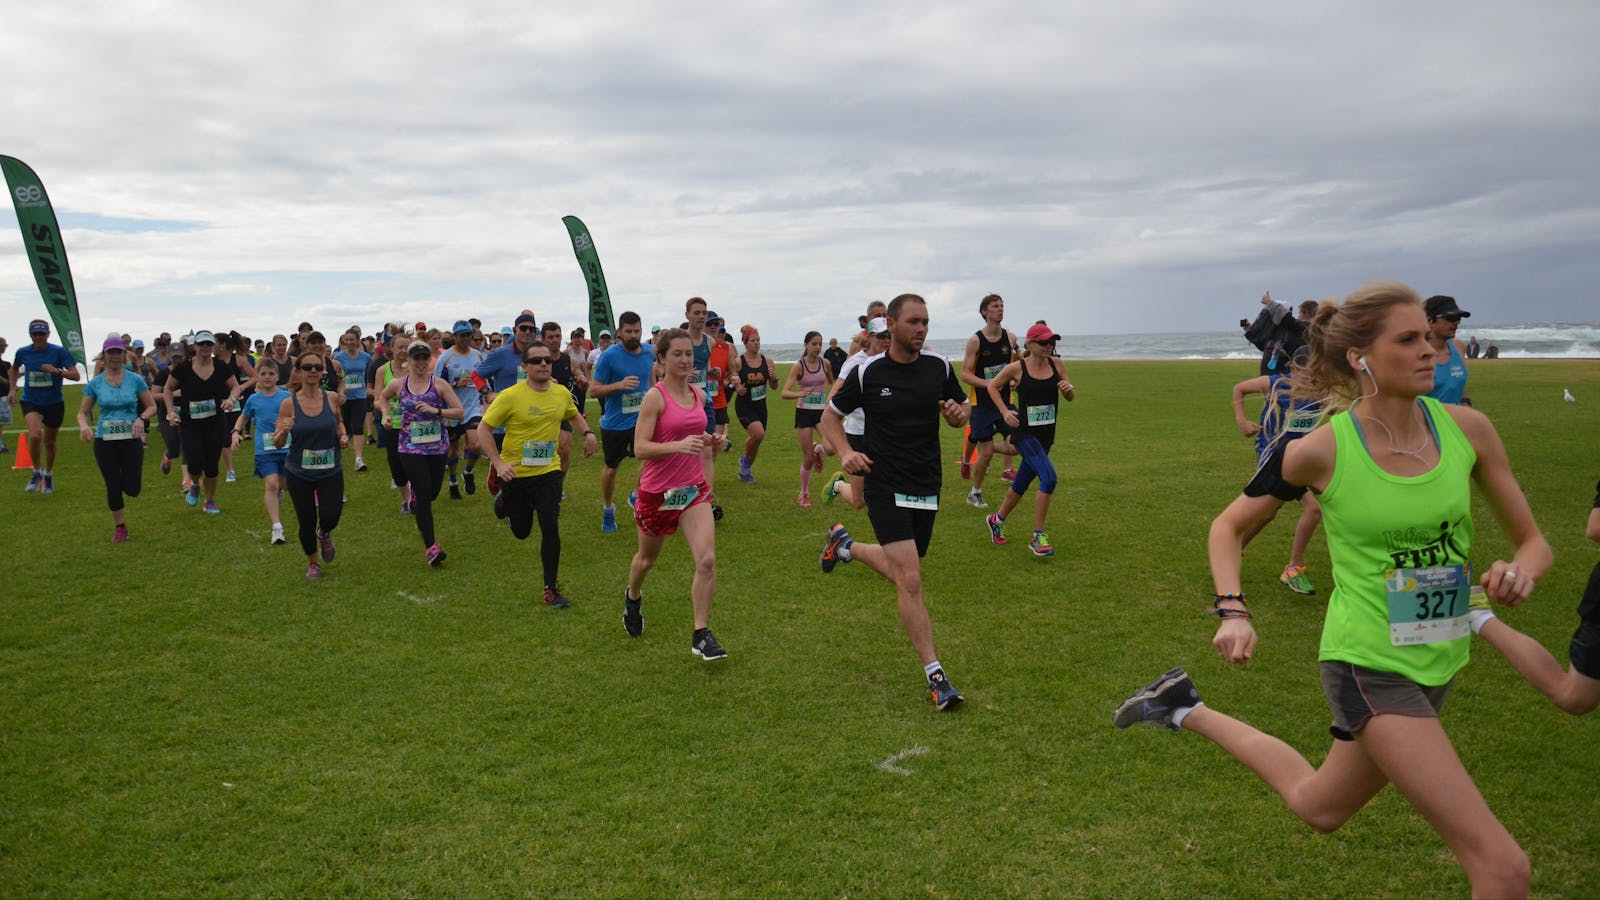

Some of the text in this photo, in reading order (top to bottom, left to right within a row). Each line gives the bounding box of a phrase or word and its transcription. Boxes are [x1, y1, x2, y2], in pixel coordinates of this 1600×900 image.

[31, 223, 71, 312] START
[588, 261, 610, 327] START
[1035, 411, 1050, 421] 272
[1293, 418, 1313, 428] 389
[109, 425, 126, 434] 283
[418, 426, 435, 437] 344
[532, 448, 549, 458] 321
[310, 456, 329, 466] 308
[669, 494, 688, 505] 319
[1390, 545, 1441, 569] FIT
[1415, 589, 1458, 620] 327
